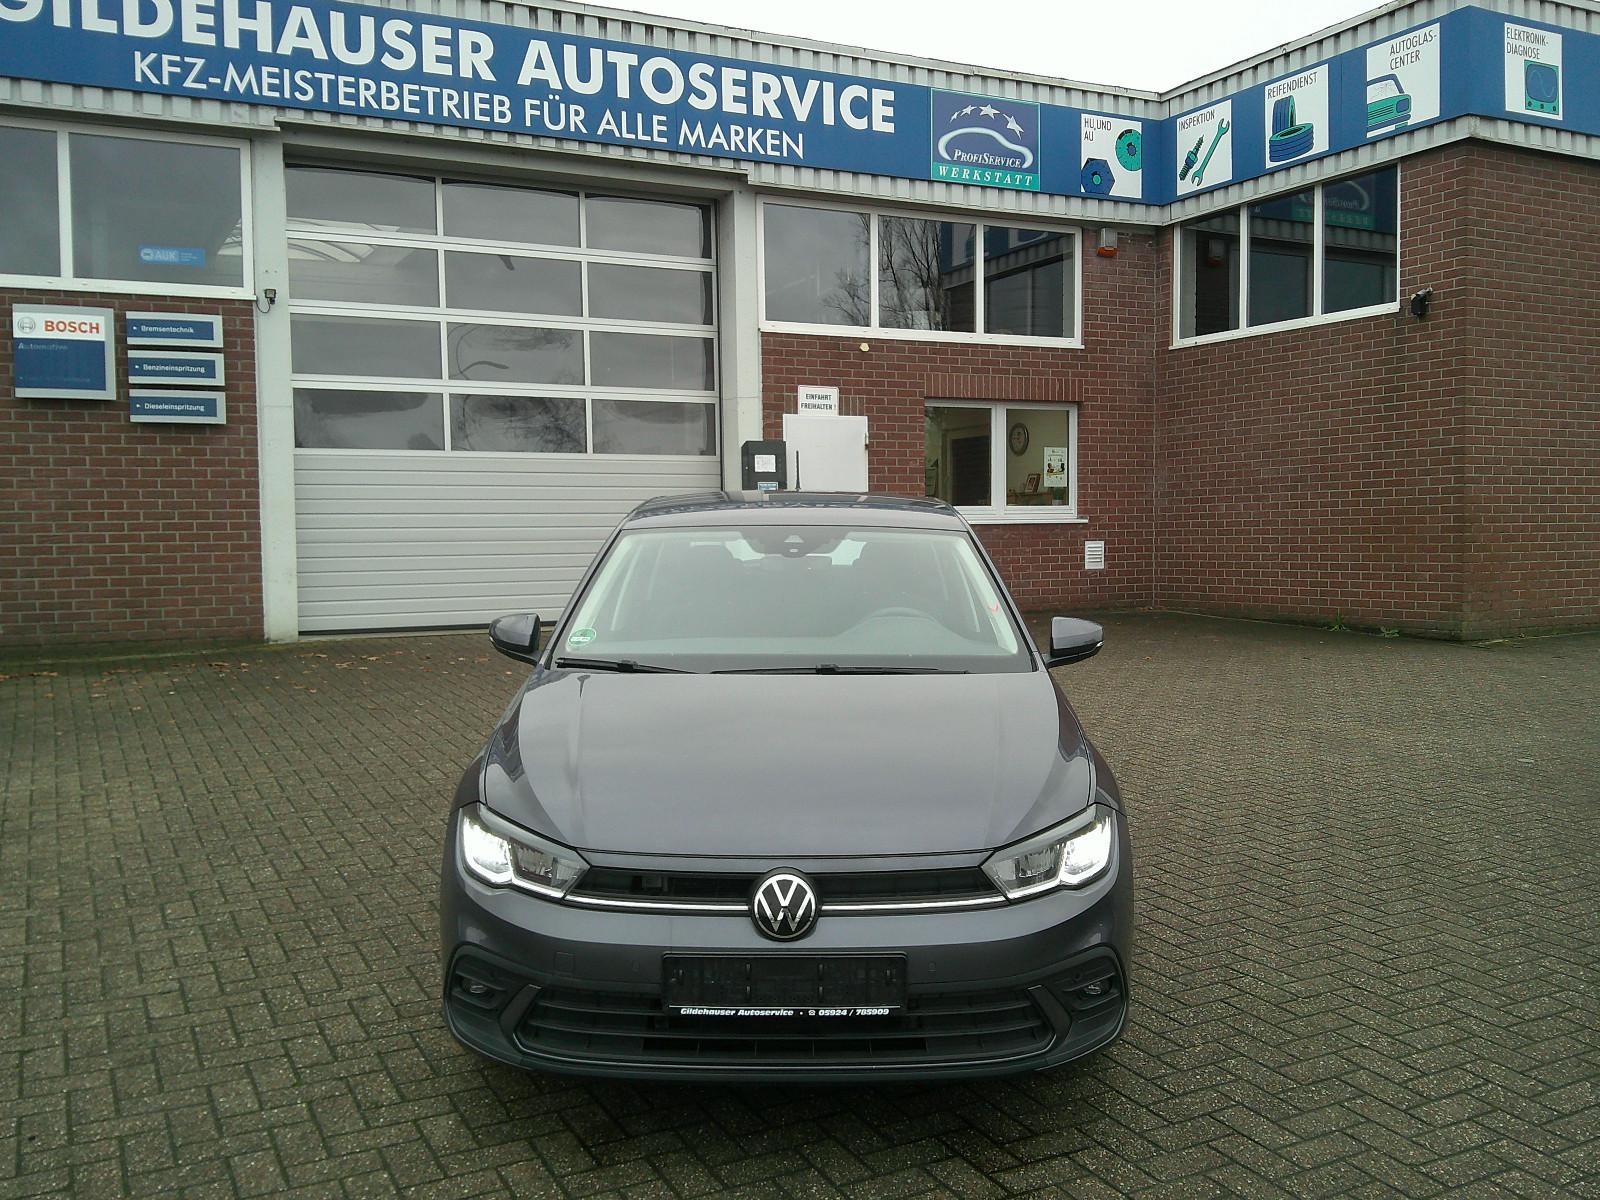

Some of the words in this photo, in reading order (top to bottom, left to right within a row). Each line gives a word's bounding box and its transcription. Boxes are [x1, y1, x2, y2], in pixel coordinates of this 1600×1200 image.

[1389, 31, 1438, 57] AUTOGLAS-
[1506, 27, 1549, 48] ELEKTRONIK-
[1506, 42, 1541, 60] DIAGNOSE
[1389, 50, 1421, 71] CENTER
[517, 39, 895, 134] AUTOSERVICE
[1267, 71, 1318, 100] REIFENDIENST
[134, 50, 511, 125] KFZ-MEISTERBETRIEB
[525, 94, 588, 135] FÜR
[597, 109, 668, 144] ALLE
[678, 119, 804, 160] MARKEN
[1178, 109, 1216, 132] INSPEKTION
[1084, 130, 1094, 142] AU
[938, 165, 1034, 187] WERKSTATT
[44, 320, 100, 334] BOSCH
[141, 325, 194, 334] Bremsentechnik
[143, 363, 206, 374] Benzineinspritzung
[805, 393, 832, 401] EINFAHRT
[144, 402, 205, 412] Dieseleinspritzung
[800, 402, 833, 411] FREIHALTEN
[680, 1008, 736, 1016] Gildehauser
